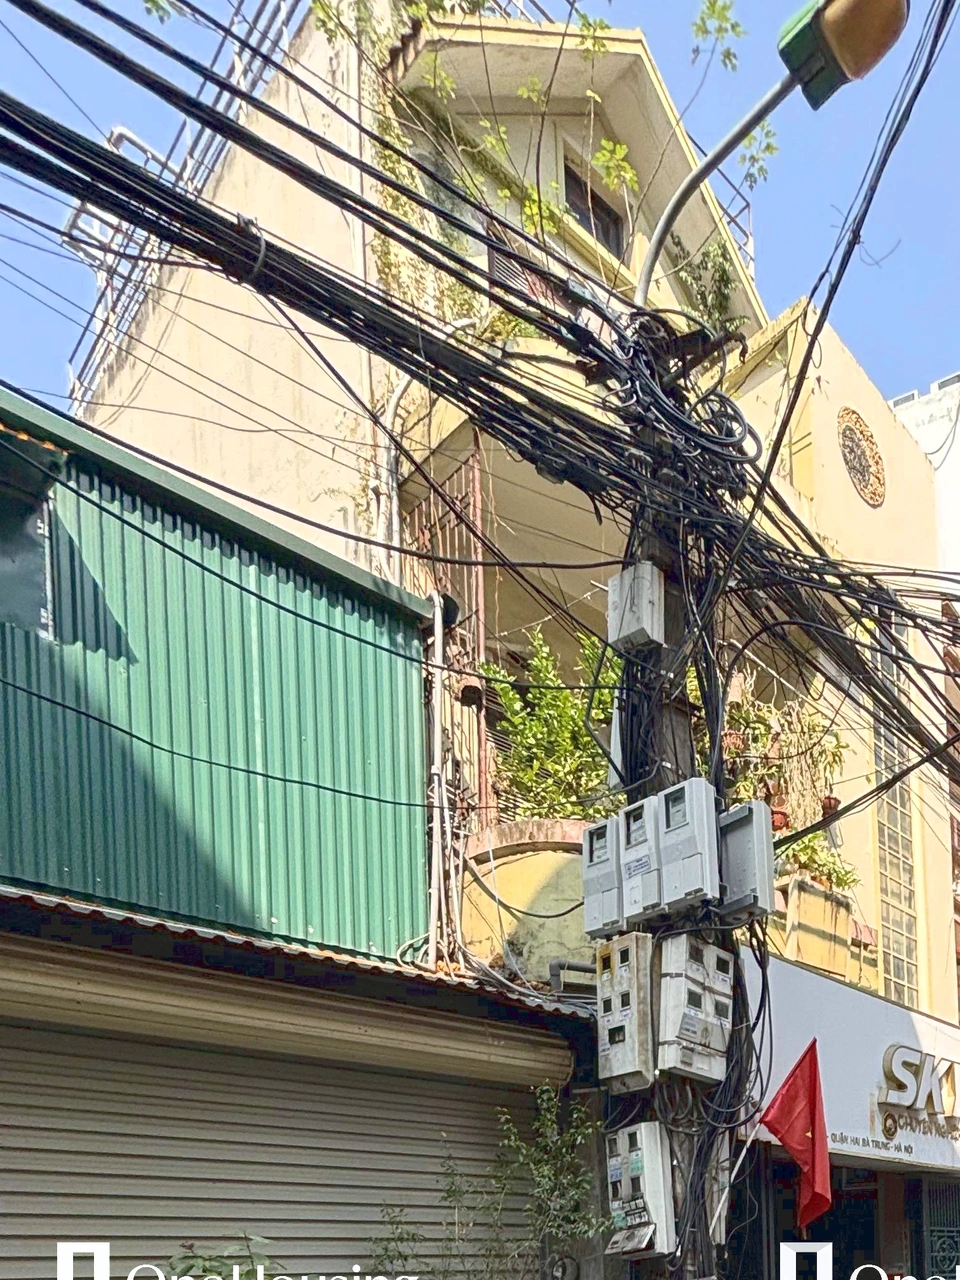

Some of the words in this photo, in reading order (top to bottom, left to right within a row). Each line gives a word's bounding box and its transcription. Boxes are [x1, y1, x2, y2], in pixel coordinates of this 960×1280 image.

[830, 1132, 848, 1146] QUẬN
[849, 1135, 861, 1147] HAI
[861, 1136, 870, 1148] BÀ
[871, 1139, 890, 1151] TRUNG
[894, 1141, 903, 1153] HÀ
[903, 1144, 913, 1157] NỘI
